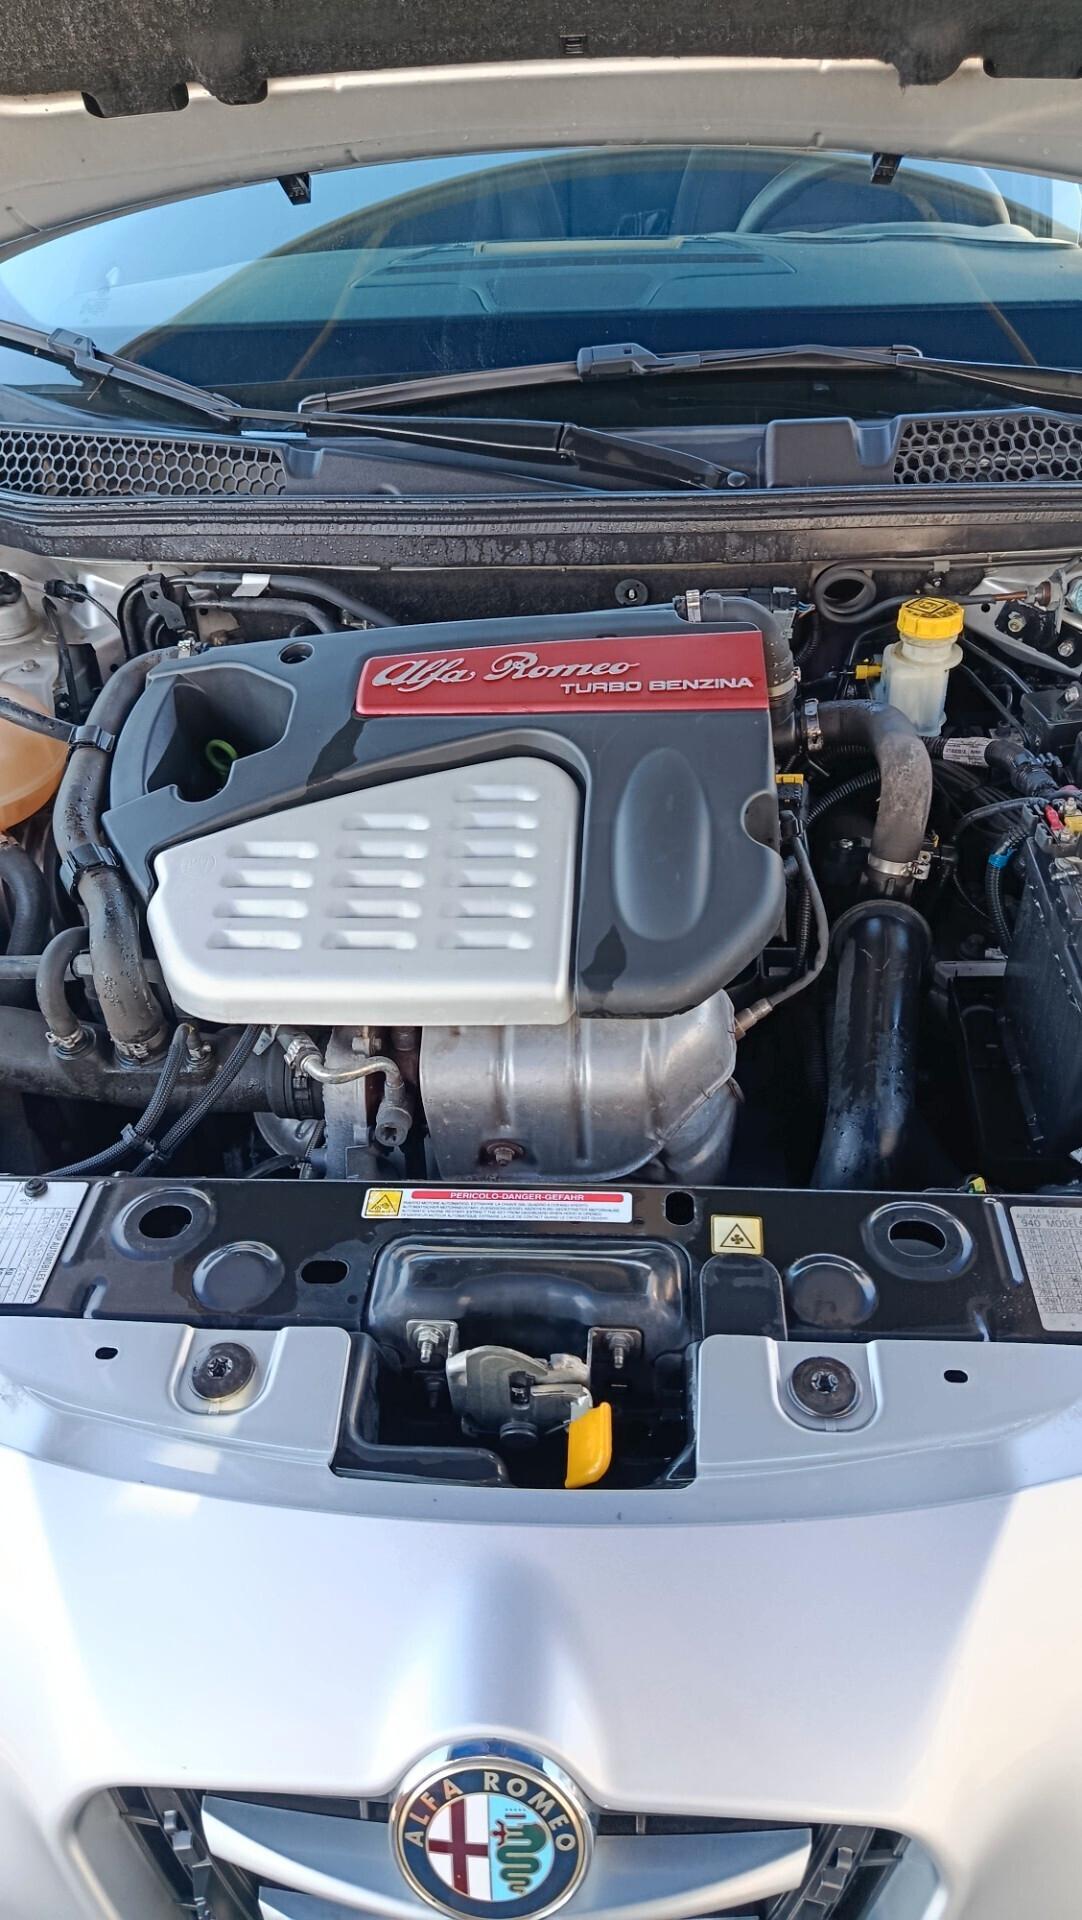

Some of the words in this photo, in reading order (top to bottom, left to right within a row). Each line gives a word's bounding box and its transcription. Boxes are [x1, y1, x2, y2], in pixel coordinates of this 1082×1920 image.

[372, 657, 475, 692] Alfa
[483, 651, 640, 681] Romeo
[560, 681, 643, 695] TURBO
[649, 677, 753, 692] BENZINA
[450, 1192, 585, 1202] PERICOLO-DANGER-GEFAHR
[63, 1210, 74, 1221] FIAT
[404, 1778, 463, 1848] ALFA
[483, 1771, 576, 1851] ROMEO
